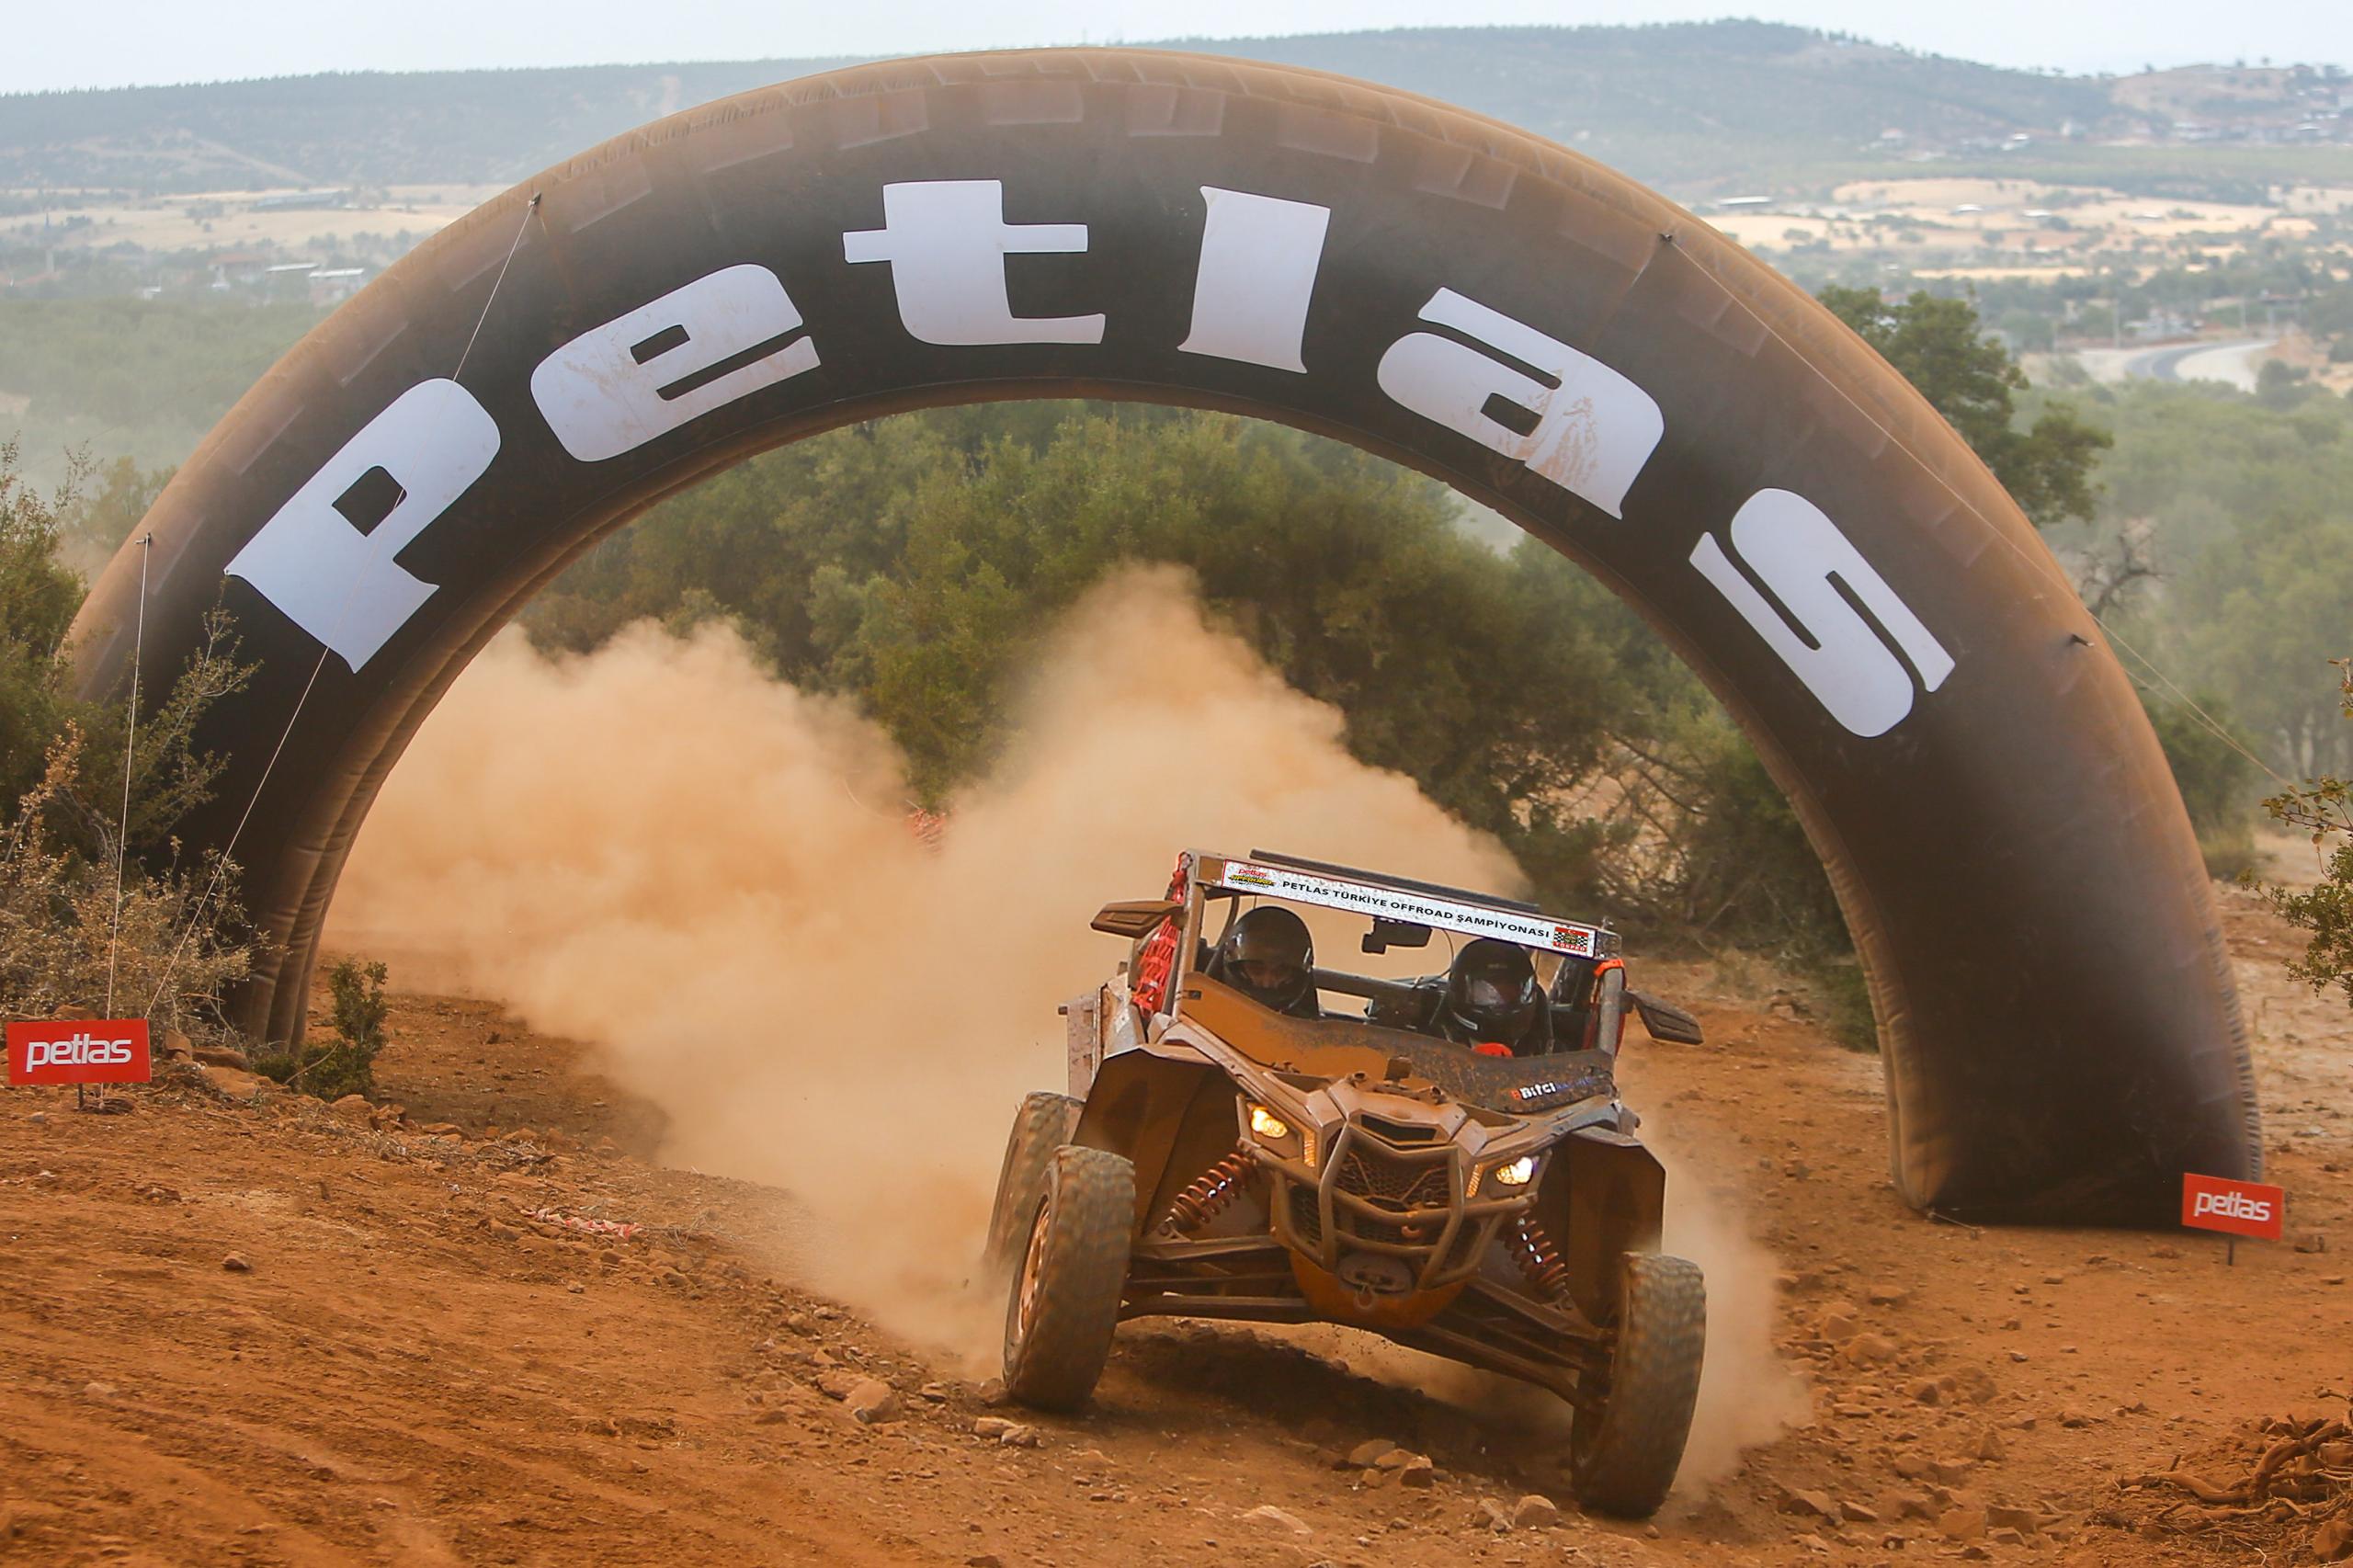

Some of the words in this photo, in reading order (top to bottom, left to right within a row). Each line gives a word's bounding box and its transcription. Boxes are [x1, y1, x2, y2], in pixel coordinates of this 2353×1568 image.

[225, 179, 1955, 737] petlas
[1282, 881, 1329, 895] PETLAS
[1333, 890, 1387, 906] TÜRKİYE
[1391, 902, 1453, 919] OFFROAD
[1457, 915, 1550, 937] ŞAMPİYONASI
[26, 1033, 132, 1073] petlas
[2193, 1191, 2271, 1221] petlas
